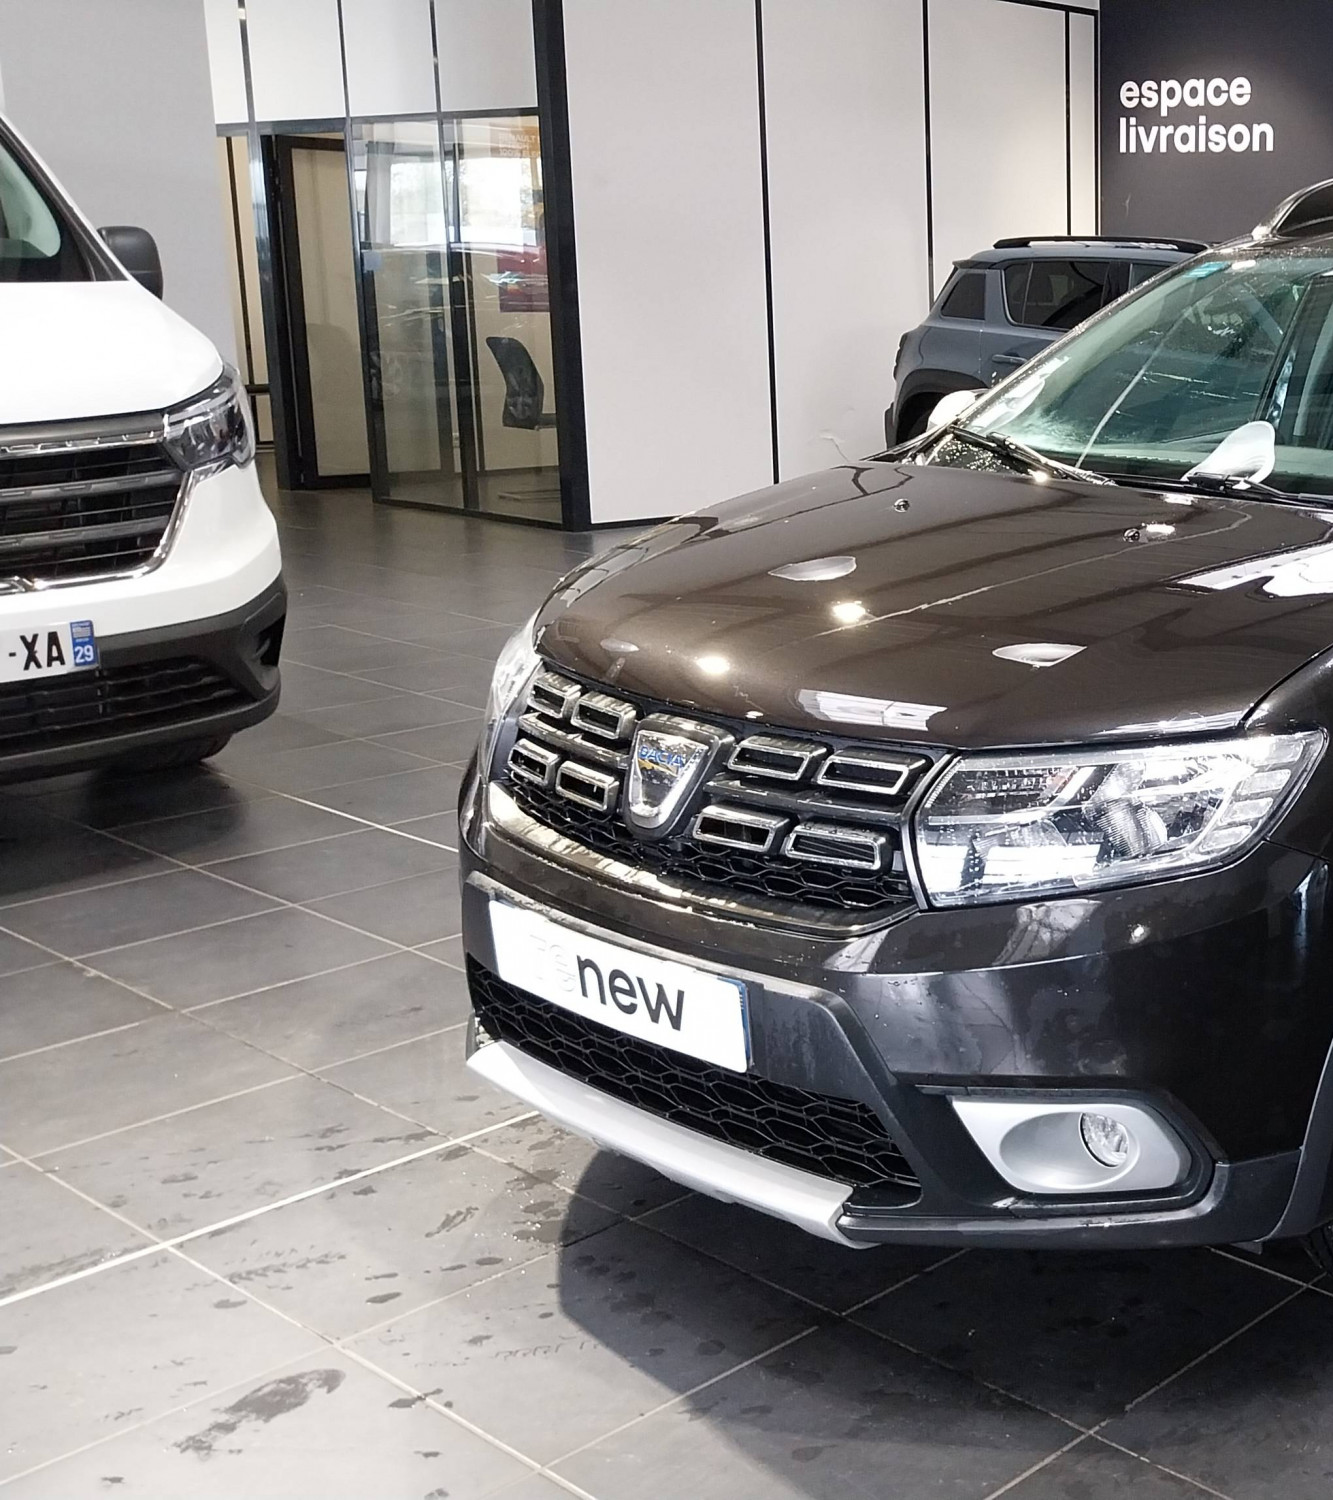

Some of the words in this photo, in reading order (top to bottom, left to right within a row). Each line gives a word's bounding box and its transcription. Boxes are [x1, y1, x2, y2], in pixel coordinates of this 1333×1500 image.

[1120, 76, 1252, 117] espace
[1119, 115, 1275, 154] livraison
[74, 645, 94, 663] 29
